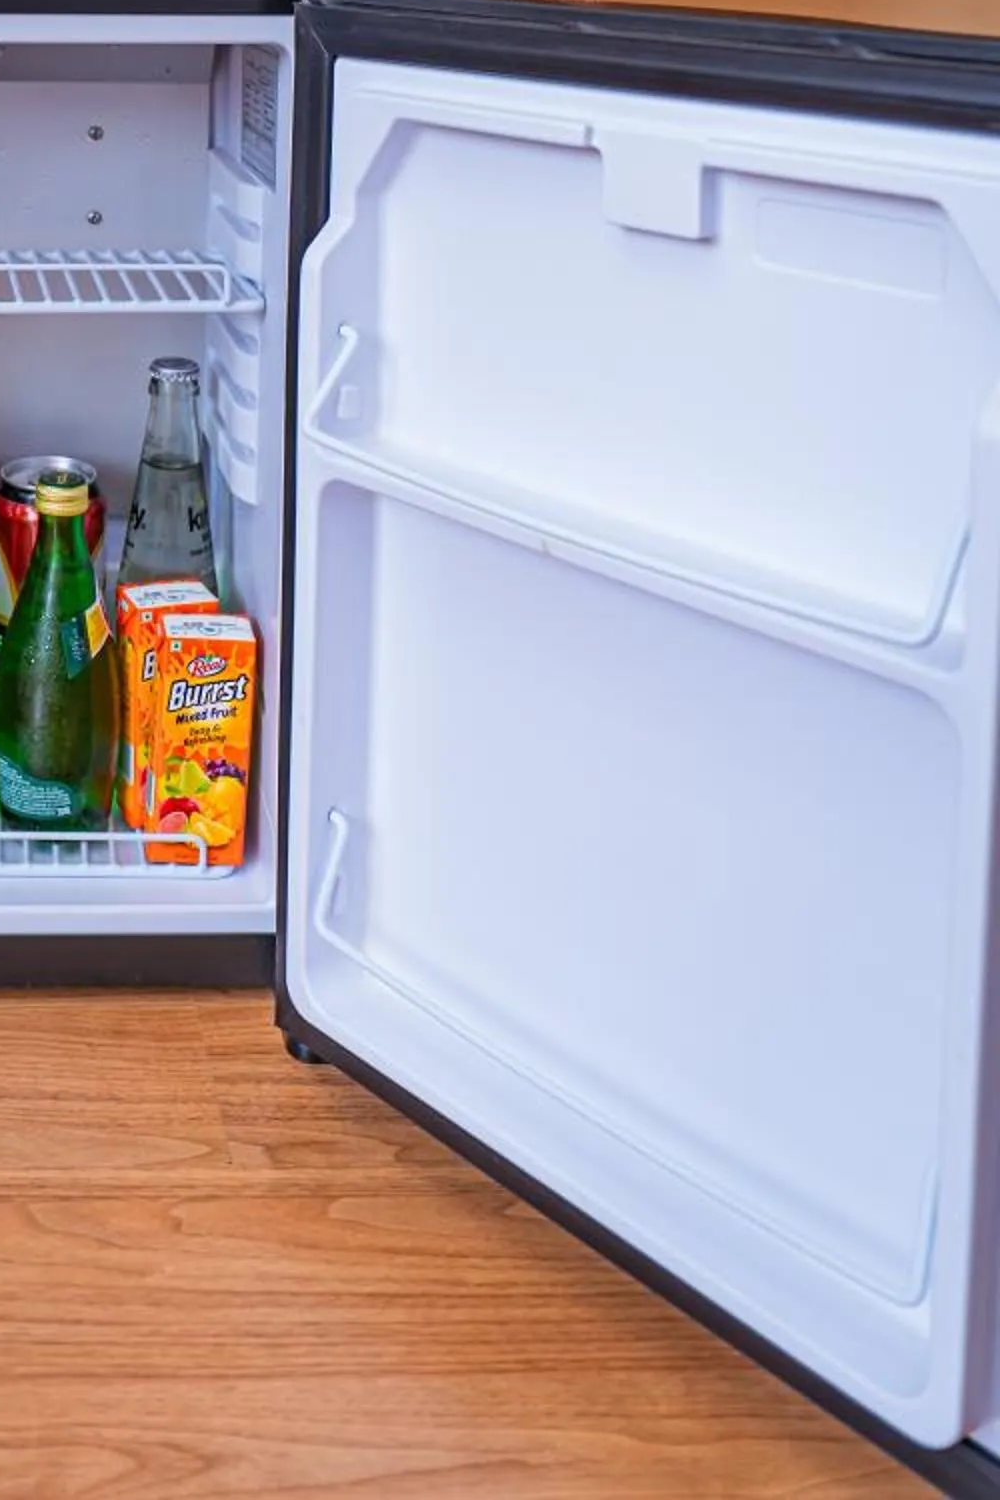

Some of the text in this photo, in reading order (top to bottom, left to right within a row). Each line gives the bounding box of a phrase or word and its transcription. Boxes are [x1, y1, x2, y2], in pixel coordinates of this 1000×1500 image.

[167, 674, 249, 712] Burrst
[175, 706, 237, 725] Mixed Fruit
